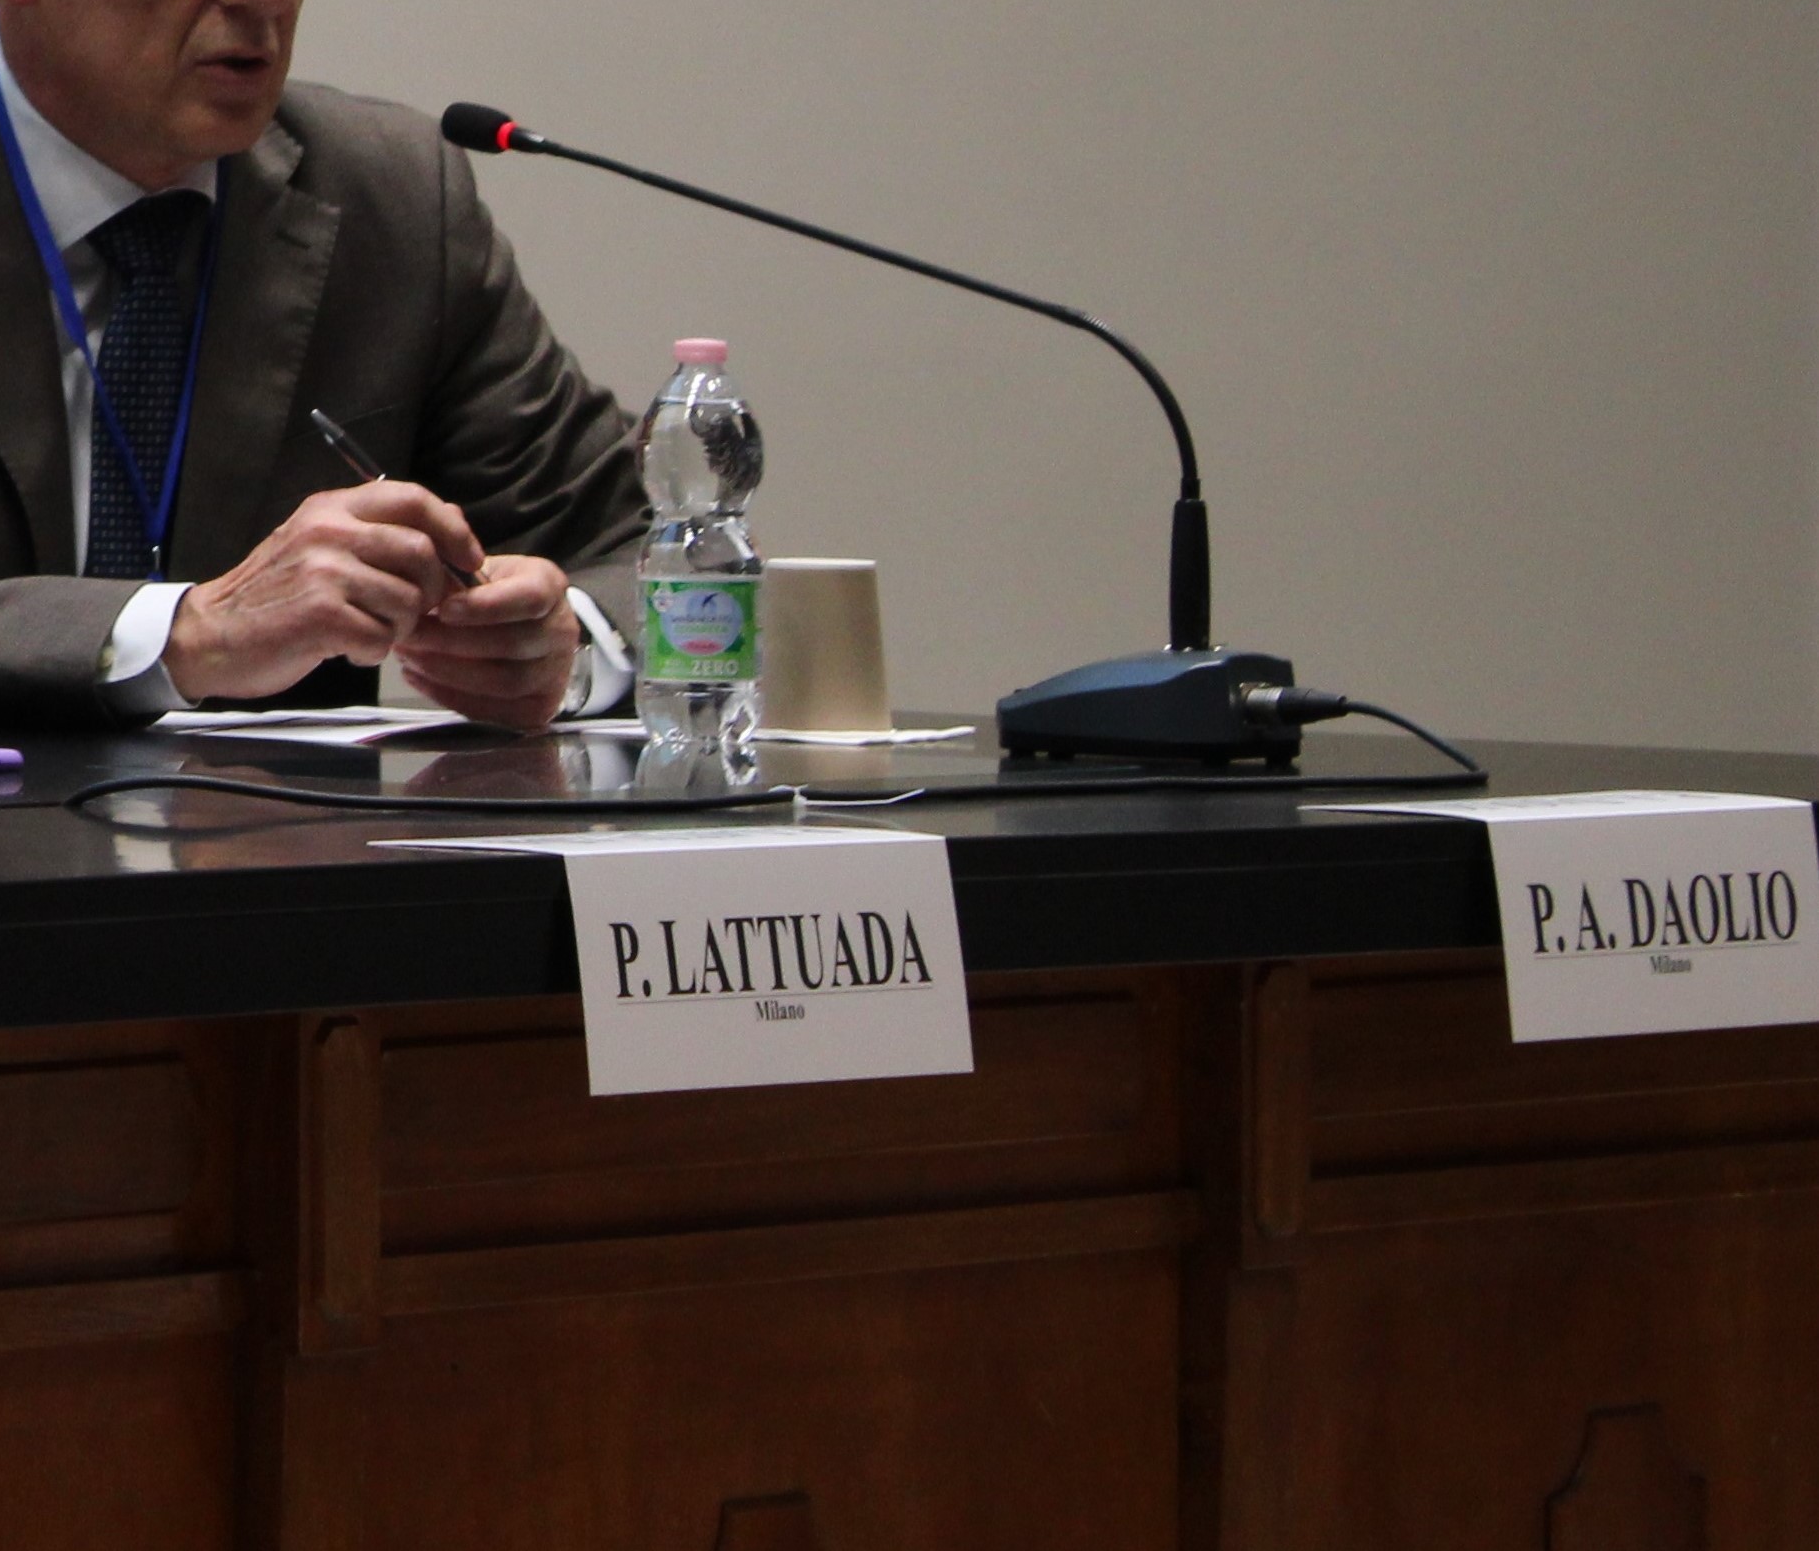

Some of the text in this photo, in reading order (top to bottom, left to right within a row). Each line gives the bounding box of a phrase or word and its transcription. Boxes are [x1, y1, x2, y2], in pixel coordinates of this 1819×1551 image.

[1527, 870, 1798, 954] P. A. DAOLIO
[609, 910, 933, 998] P. LATTUADA
[1650, 956, 1691, 974] Milano
[755, 1001, 805, 1022] Milano
